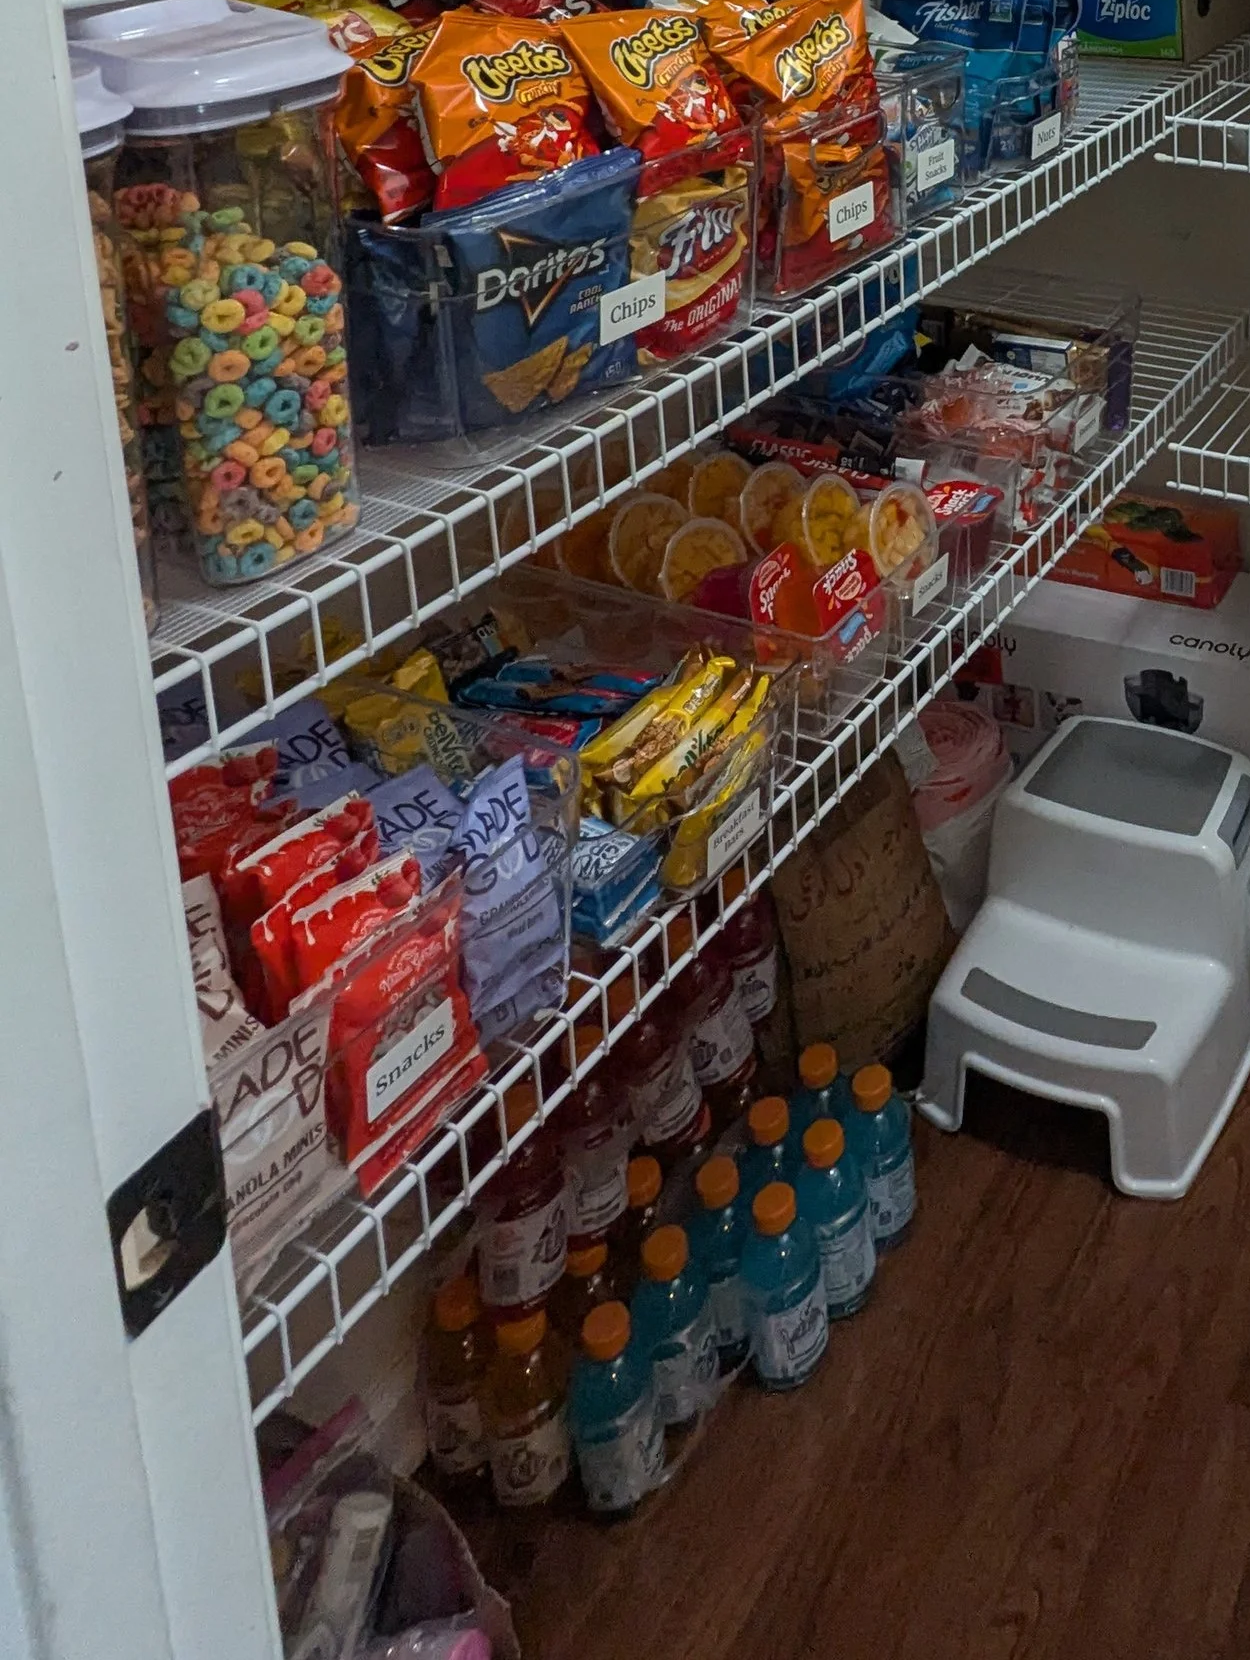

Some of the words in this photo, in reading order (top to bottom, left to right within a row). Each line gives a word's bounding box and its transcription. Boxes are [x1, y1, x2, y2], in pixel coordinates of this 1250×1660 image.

[464, 43, 570, 101] Cheetos
[612, 17, 699, 88] Cheetos
[776, 16, 851, 96] Cheetos
[515, 80, 562, 108] Crunchy
[1036, 125, 1056, 147] Nuts
[836, 200, 868, 226] Chips
[476, 238, 607, 311] Doritos
[611, 294, 656, 324] Chips
[663, 319, 684, 332] The
[278, 720, 340, 765] ADE
[377, 789, 449, 842] ADE
[713, 802, 755, 849] Breakfast
[724, 826, 745, 852] Bars
[224, 1021, 321, 1126] ADE
[375, 1021, 446, 1098] Snacks
[284, 1122, 324, 1168] MINIS
